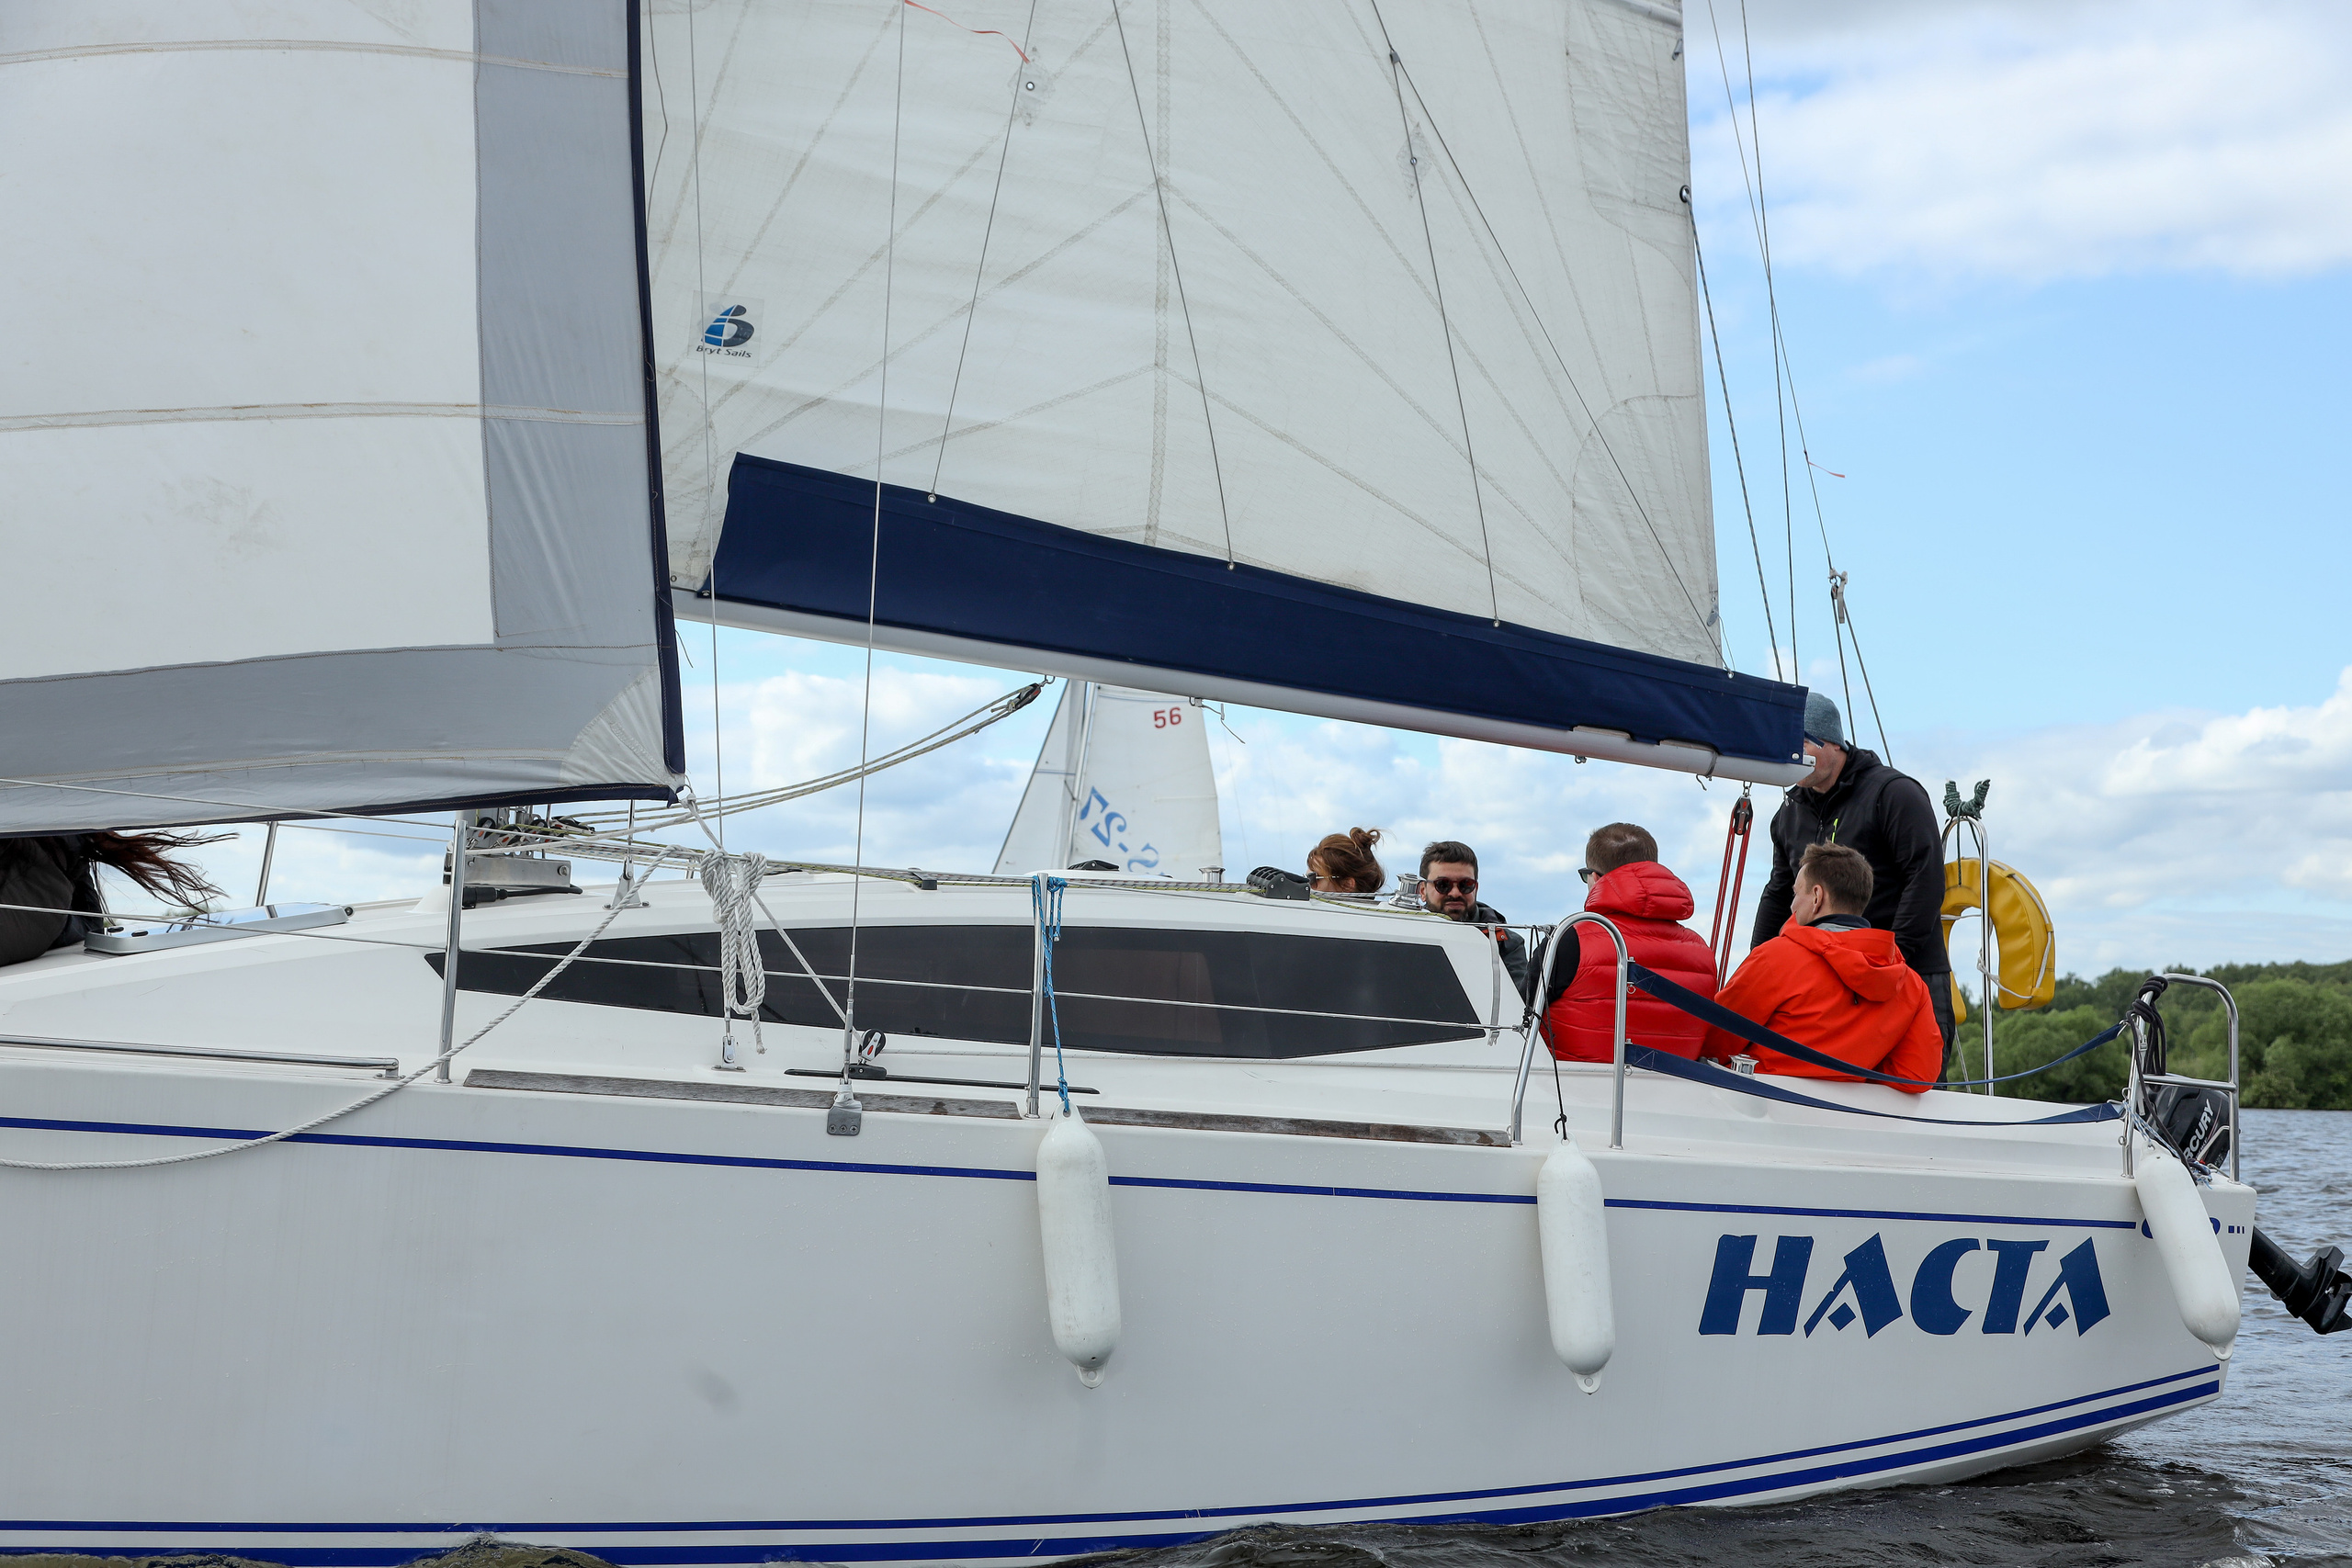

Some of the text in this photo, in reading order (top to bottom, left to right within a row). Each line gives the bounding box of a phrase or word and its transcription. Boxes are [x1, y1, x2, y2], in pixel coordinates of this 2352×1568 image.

[695, 345, 752, 357] Bryt Sails
[1153, 706, 1182, 728] 56
[2183, 1098, 2214, 1159] RCURY
[1698, 1232, 2111, 1339] НАСТА
